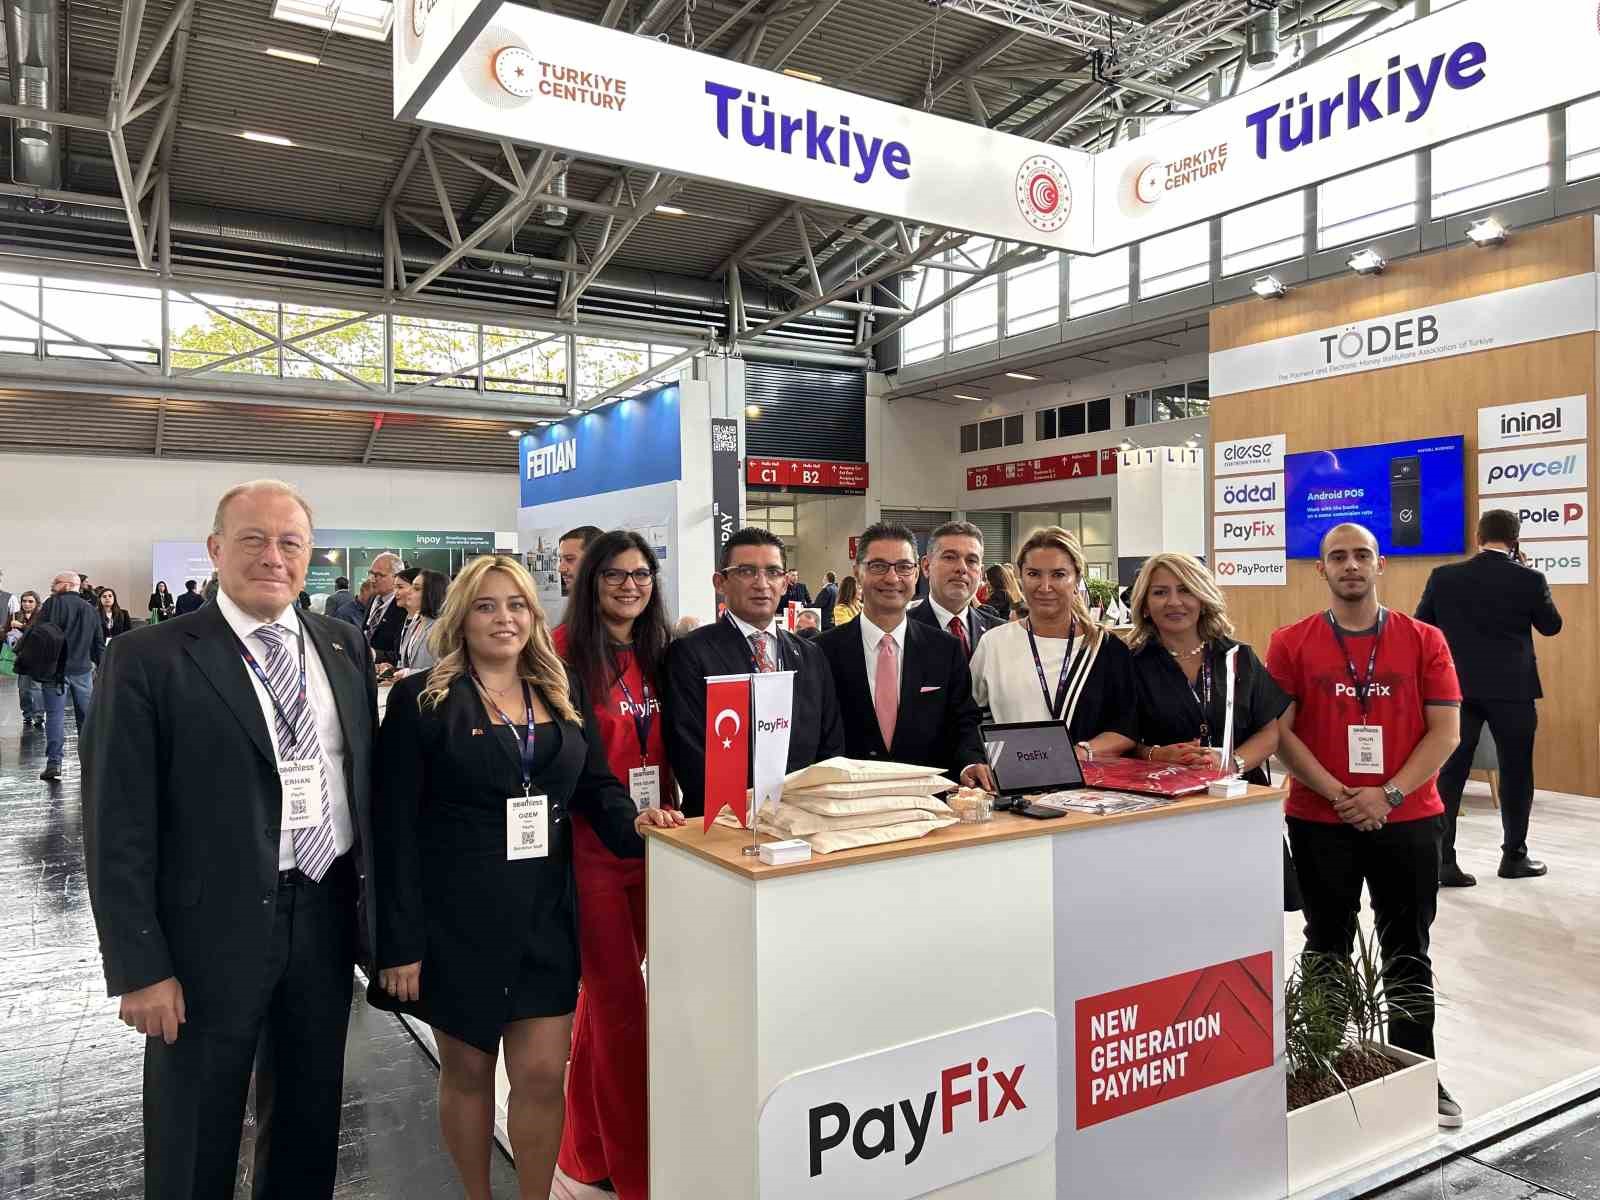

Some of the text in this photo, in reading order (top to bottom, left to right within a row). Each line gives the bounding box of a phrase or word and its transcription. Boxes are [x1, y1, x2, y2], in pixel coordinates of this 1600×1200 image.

[538, 80, 626, 111] CENTURY
[1245, 41, 1486, 160] Türkiye
[705, 80, 911, 184] Türkiye
[1164, 158, 1226, 191] CENTURY
[1319, 314, 1439, 364] TÖDEB
[1500, 407, 1561, 434] ininal
[761, 469, 777, 482] C1
[802, 470, 820, 484] B2
[975, 474, 988, 488] B2
[1071, 462, 1081, 476] A
[1487, 455, 1577, 485] paycell
[1307, 488, 1365, 501] Android POS
[416, 535, 441, 545] inpay
[1223, 520, 1276, 541] PayFix
[1237, 563, 1284, 575] PayPorter
[757, 717, 789, 734] PayFix
[1091, 1004, 1139, 1041] NEW
[1090, 1012, 1222, 1073] GENERATION
[1091, 1051, 1189, 1105] PAYMENT
[808, 1056, 1026, 1178] PayFix
